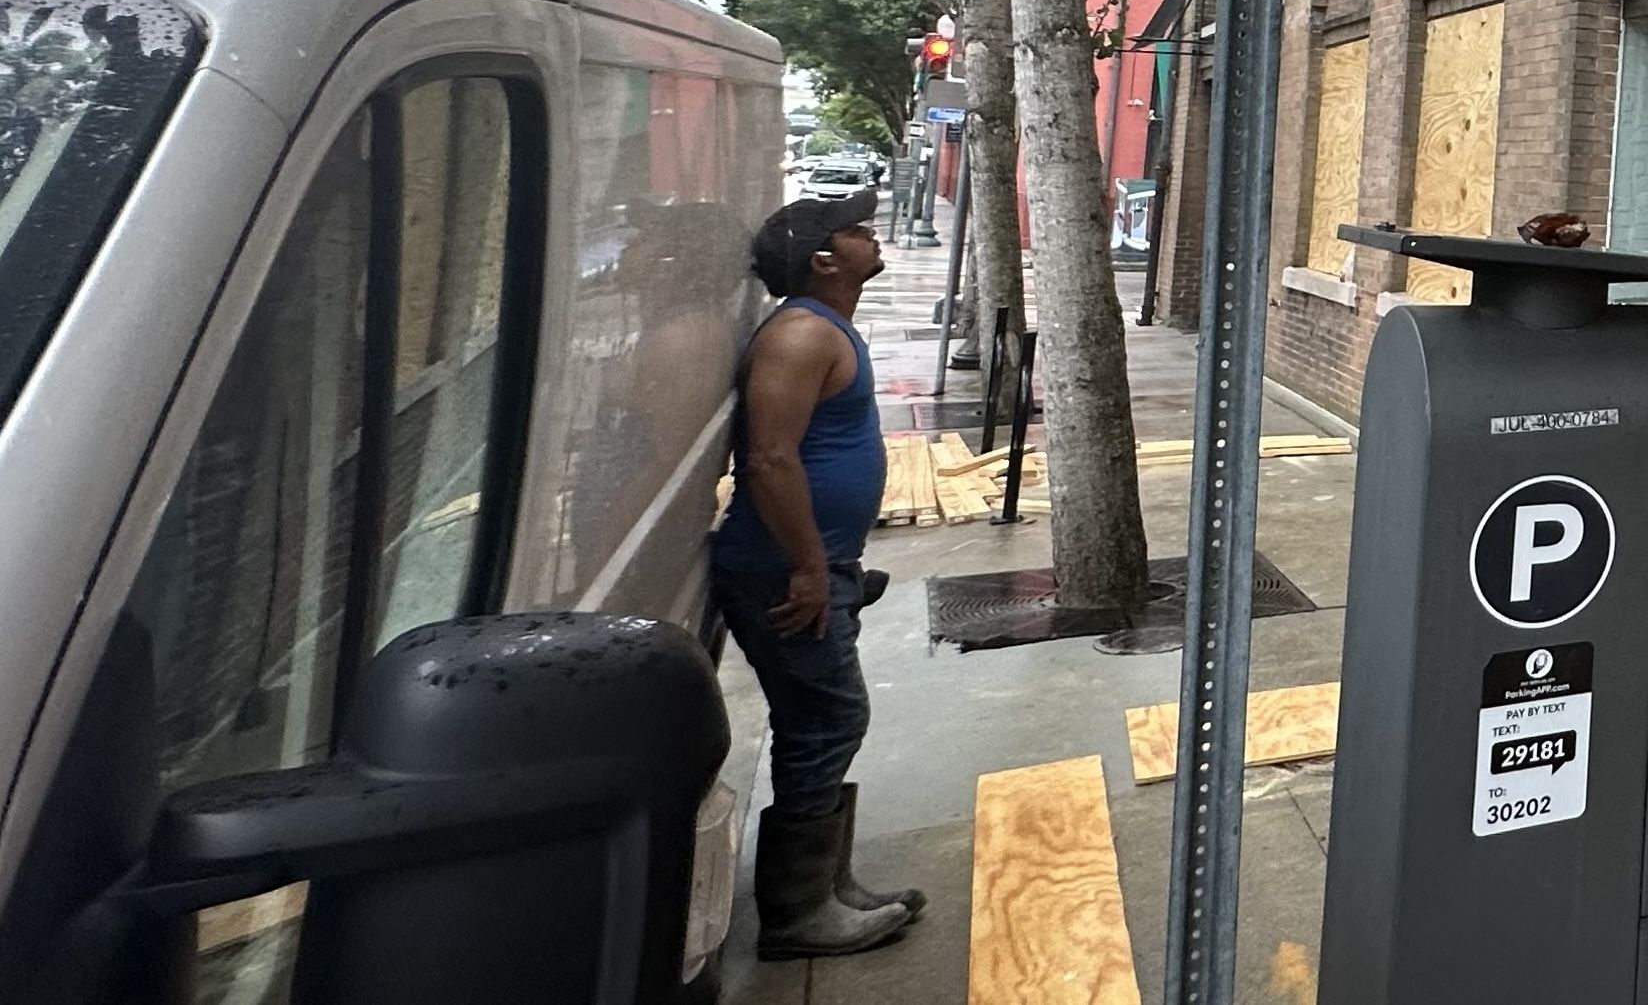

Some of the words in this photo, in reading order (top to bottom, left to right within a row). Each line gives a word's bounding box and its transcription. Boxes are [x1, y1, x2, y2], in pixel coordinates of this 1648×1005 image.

[1510, 503, 1585, 603] P
[1506, 708, 1525, 720] PAY
[1527, 706, 1540, 716] BY
[1543, 702, 1566, 714] TEXT
[1492, 724, 1520, 736] TEXT:
[1501, 738, 1566, 768] 29181
[1489, 787, 1507, 798] TO:
[1487, 795, 1552, 825] 30202
